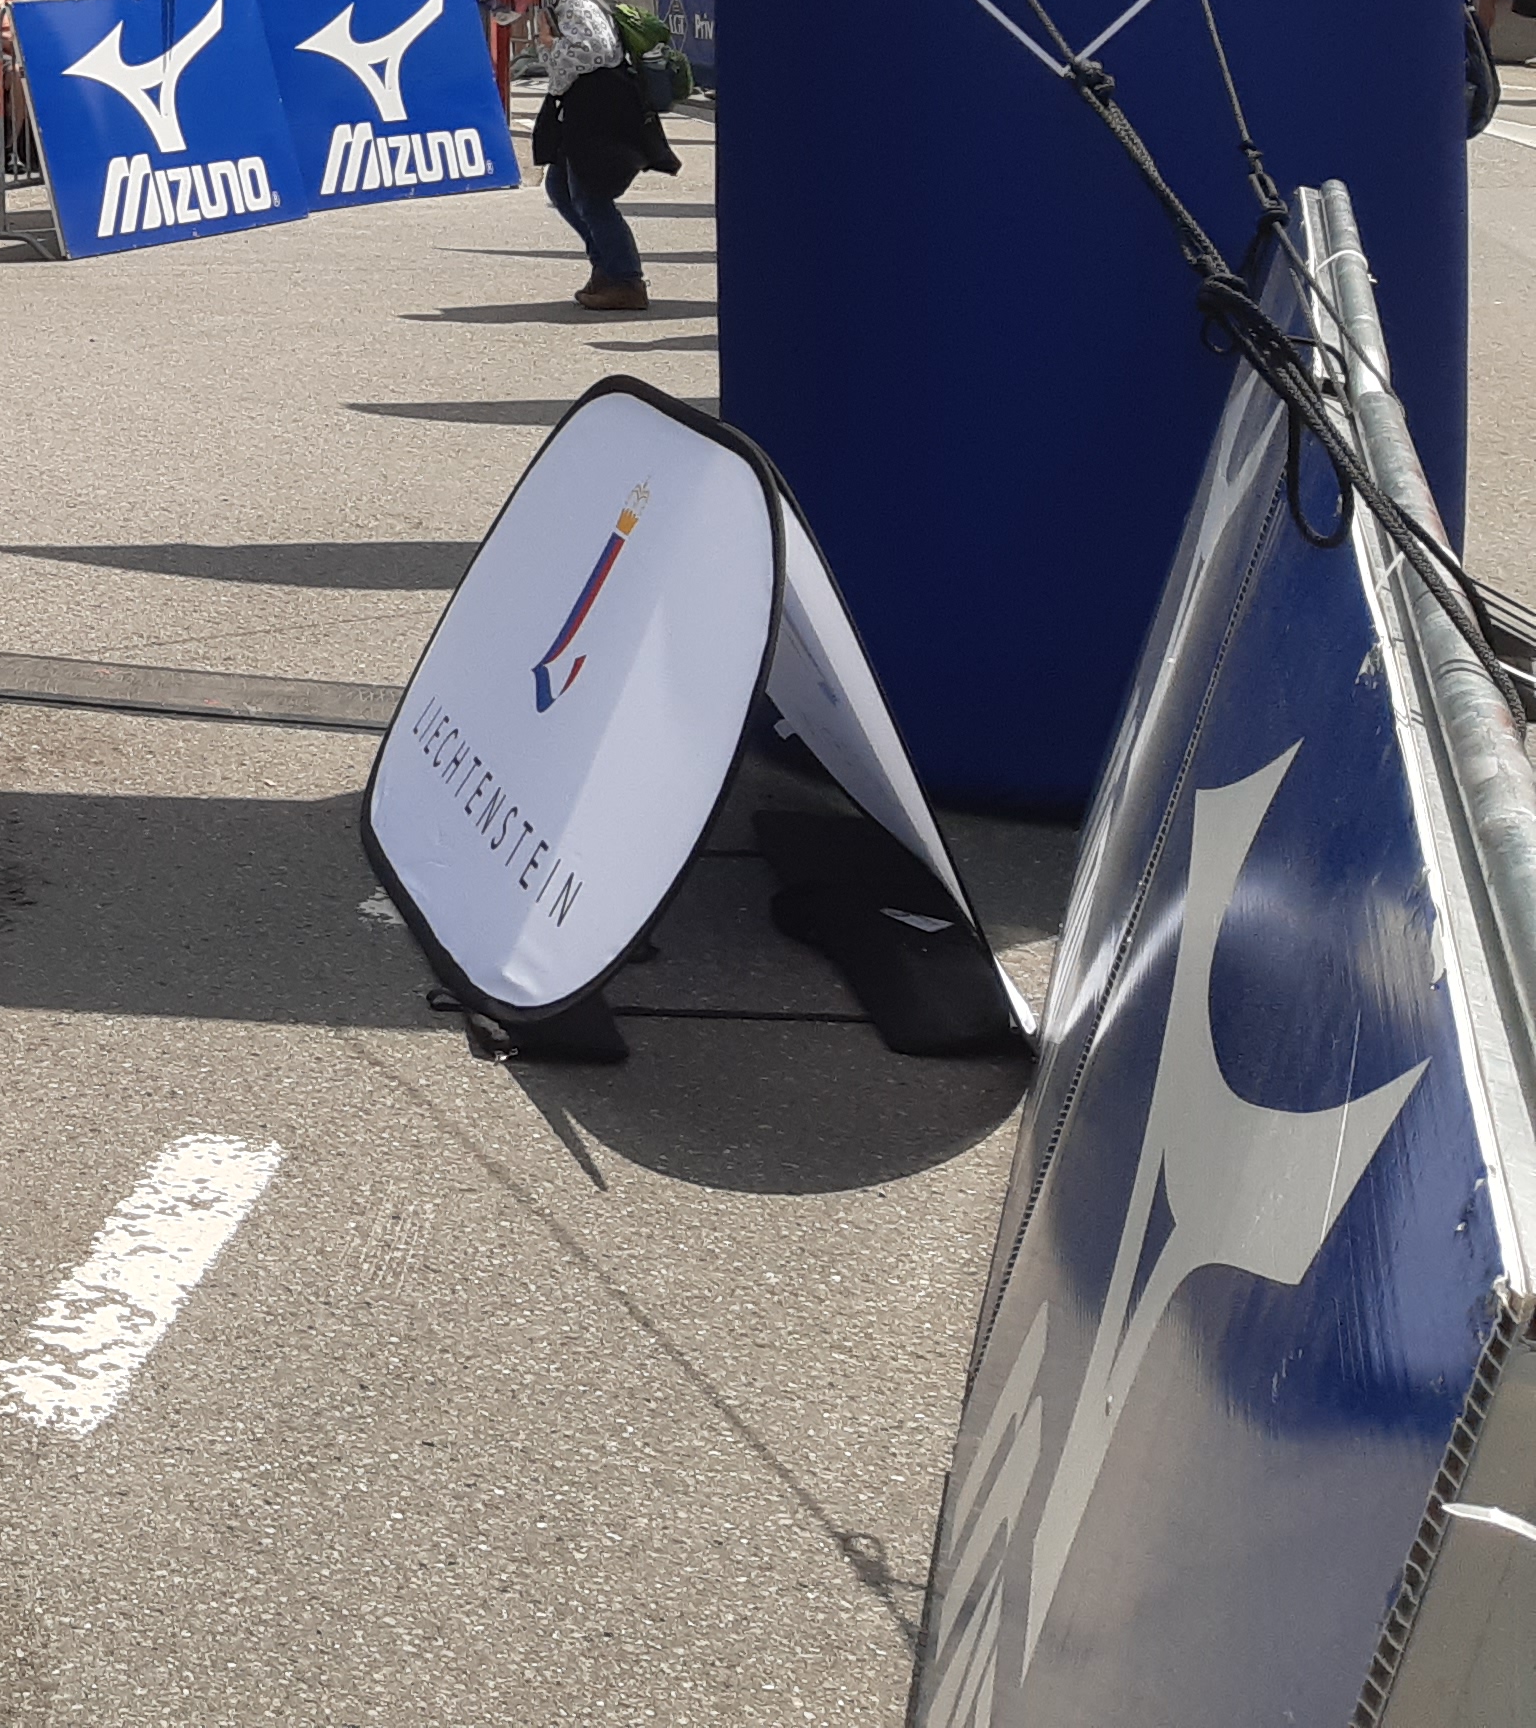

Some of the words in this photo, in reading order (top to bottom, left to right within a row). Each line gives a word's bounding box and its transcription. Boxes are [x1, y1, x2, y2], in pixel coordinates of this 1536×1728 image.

[97, 153, 272, 238] MIZUNO
[320, 122, 486, 196] MIZUNO
[411, 696, 584, 929] LIECHTENSTEIN
